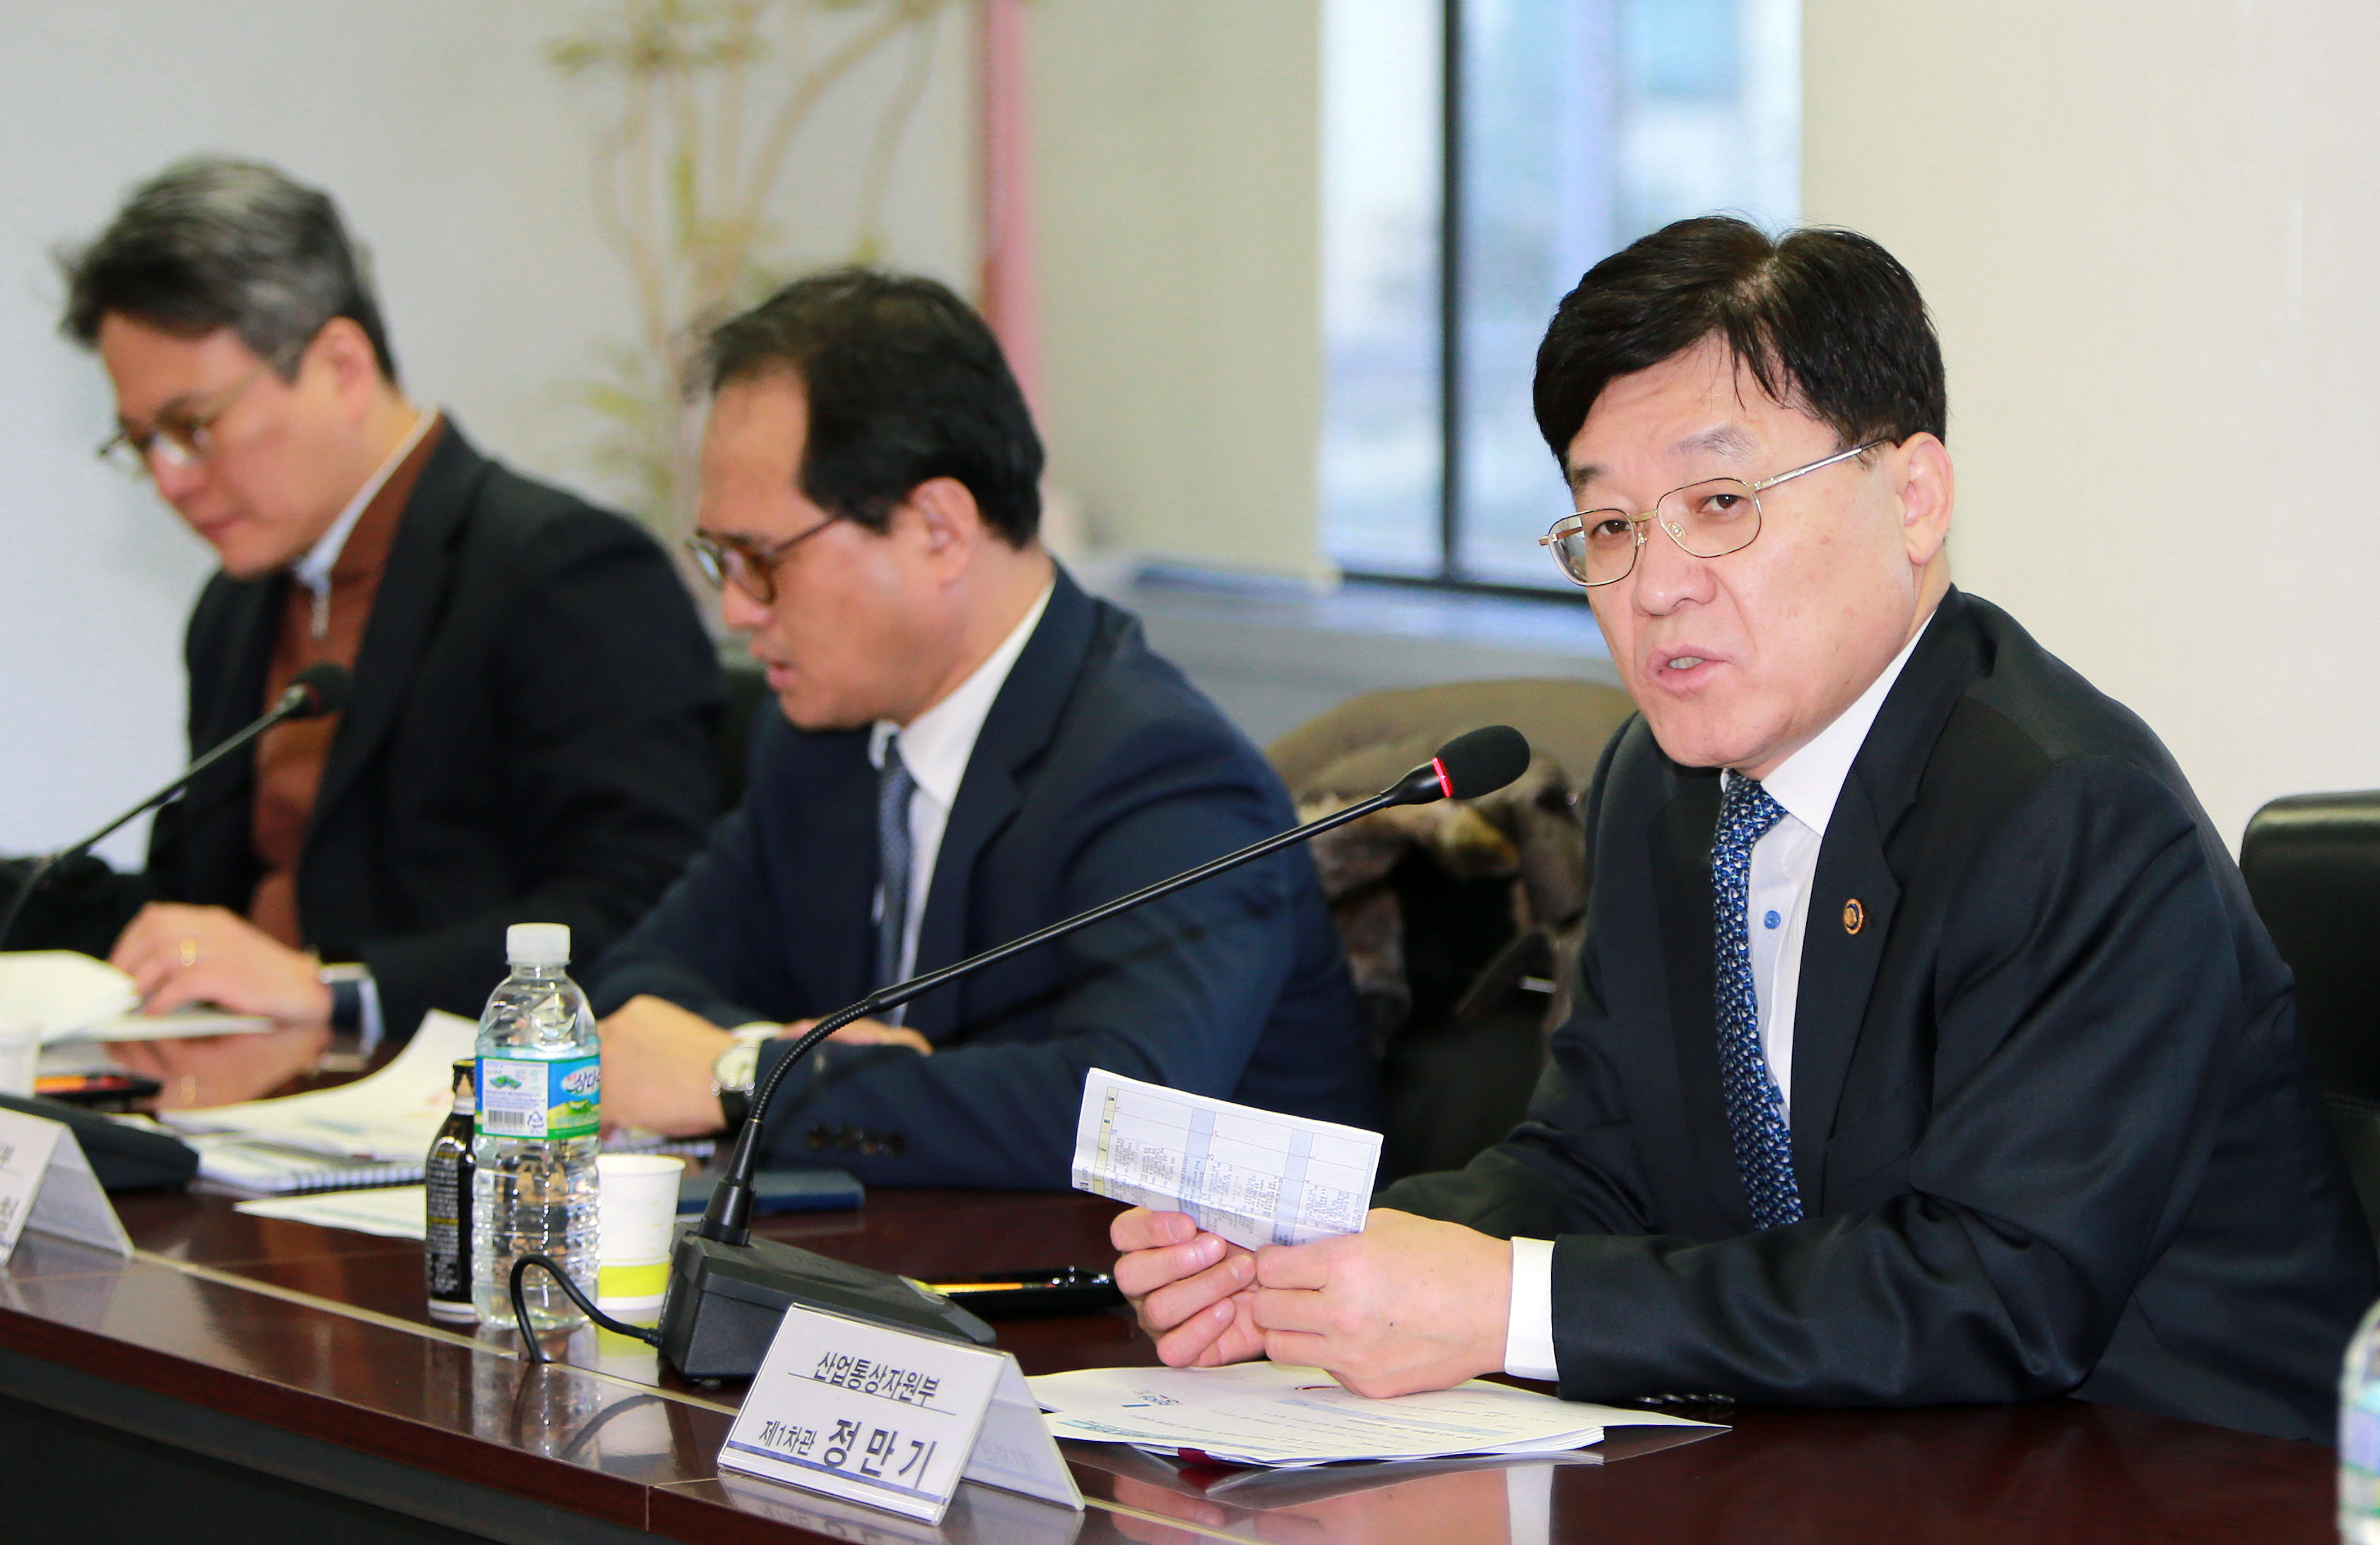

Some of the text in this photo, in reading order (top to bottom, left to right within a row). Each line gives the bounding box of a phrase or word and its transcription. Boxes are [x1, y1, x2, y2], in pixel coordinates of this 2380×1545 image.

[814, 1351, 941, 1404] 산업통상자원부
[758, 1419, 817, 1457] 제1차관
[823, 1418, 938, 1490] 정만기
